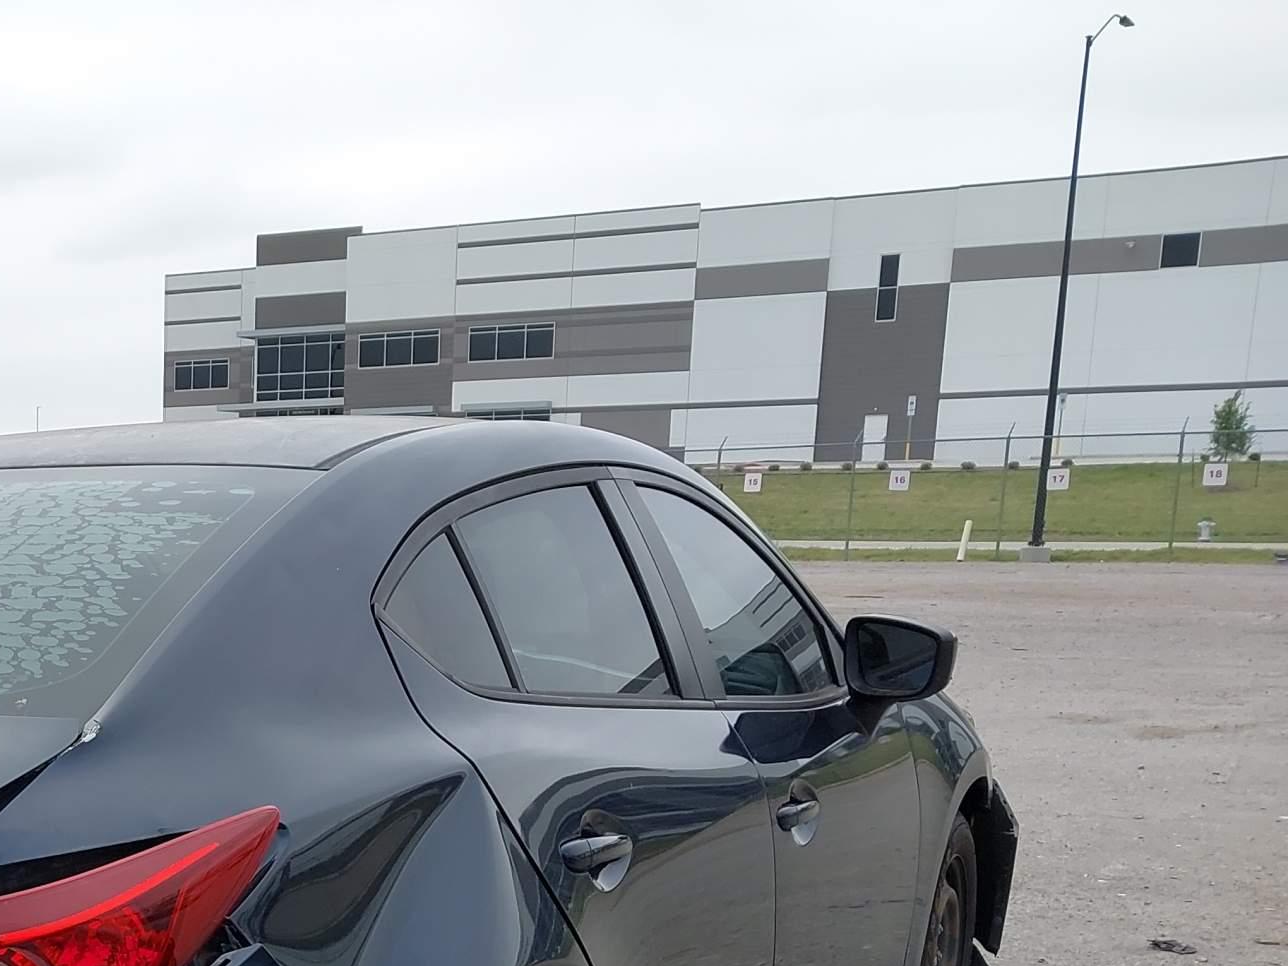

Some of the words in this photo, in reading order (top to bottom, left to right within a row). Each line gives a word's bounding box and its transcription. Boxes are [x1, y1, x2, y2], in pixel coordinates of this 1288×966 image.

[1209, 470, 1223, 479] 18
[748, 478, 758, 486] 15
[894, 476, 906, 484] 16
[1052, 475, 1065, 484] 17
